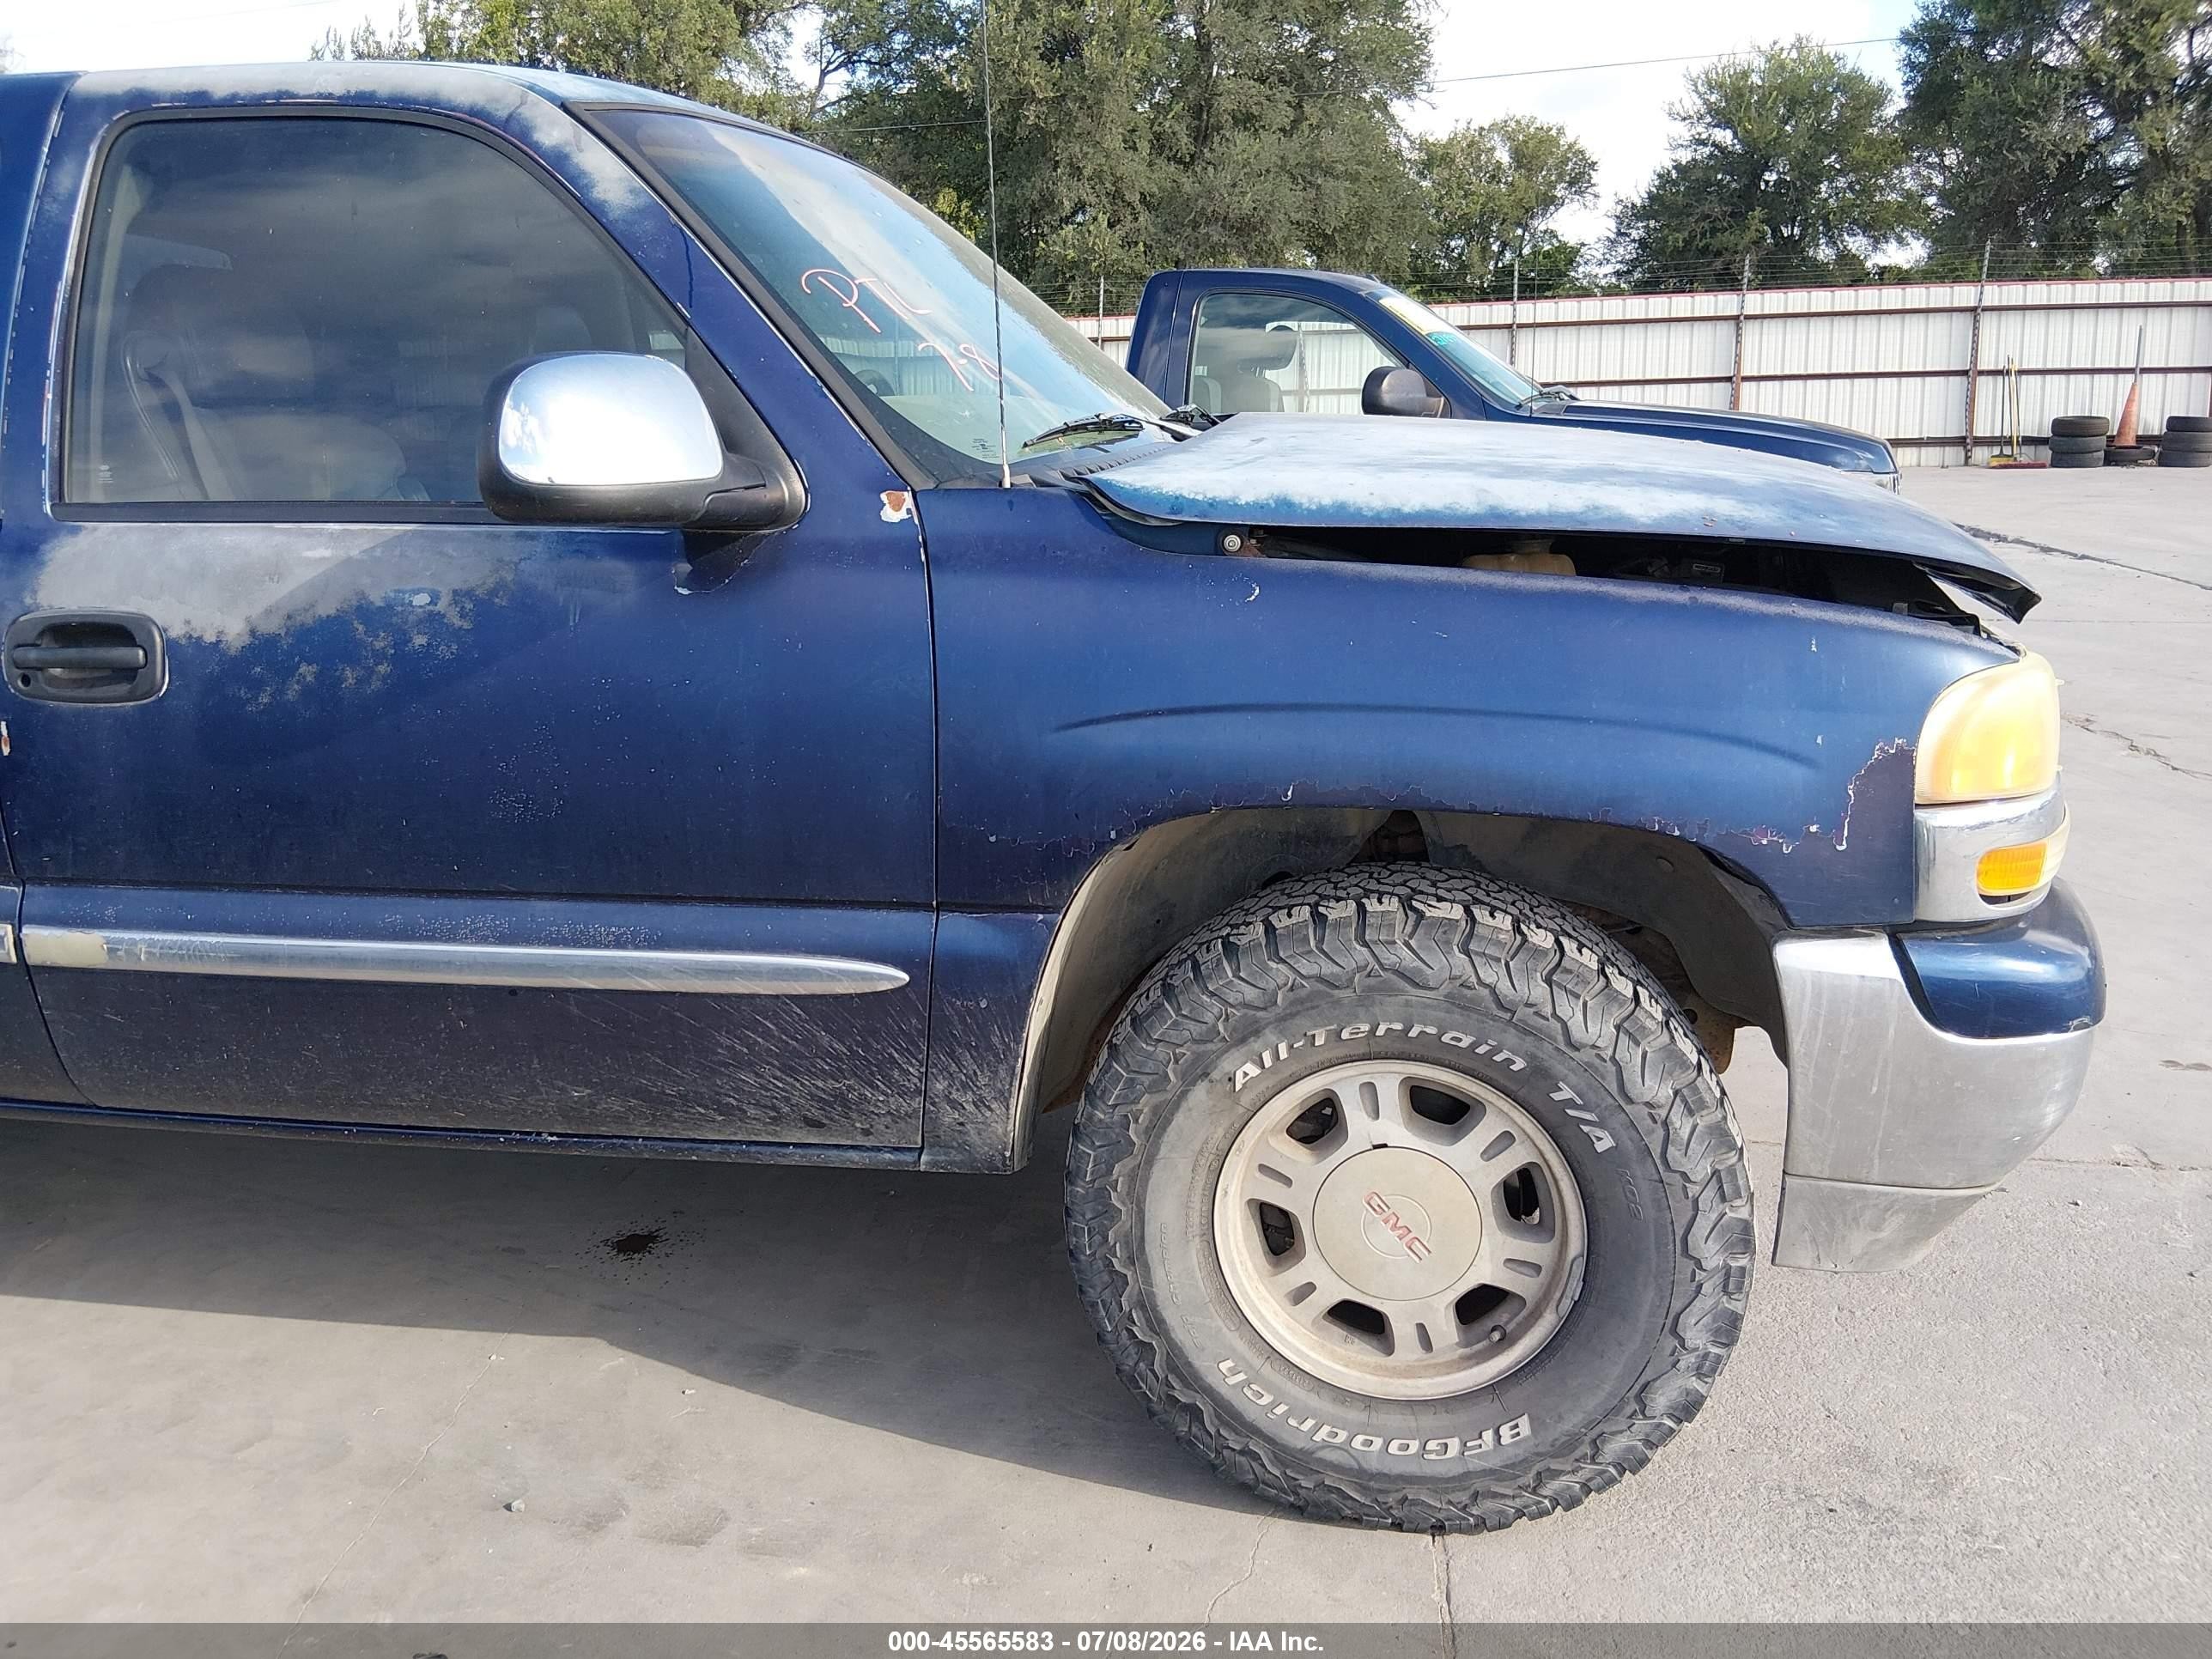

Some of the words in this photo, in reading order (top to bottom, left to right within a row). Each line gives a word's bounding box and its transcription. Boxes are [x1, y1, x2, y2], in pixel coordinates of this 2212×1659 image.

[1233, 1021, 1528, 1092] All-Terrain
[1548, 1081, 1617, 1153] T/A
[1362, 1191, 1432, 1264] GMC
[1216, 1357, 1532, 1461] BFGoodrich
